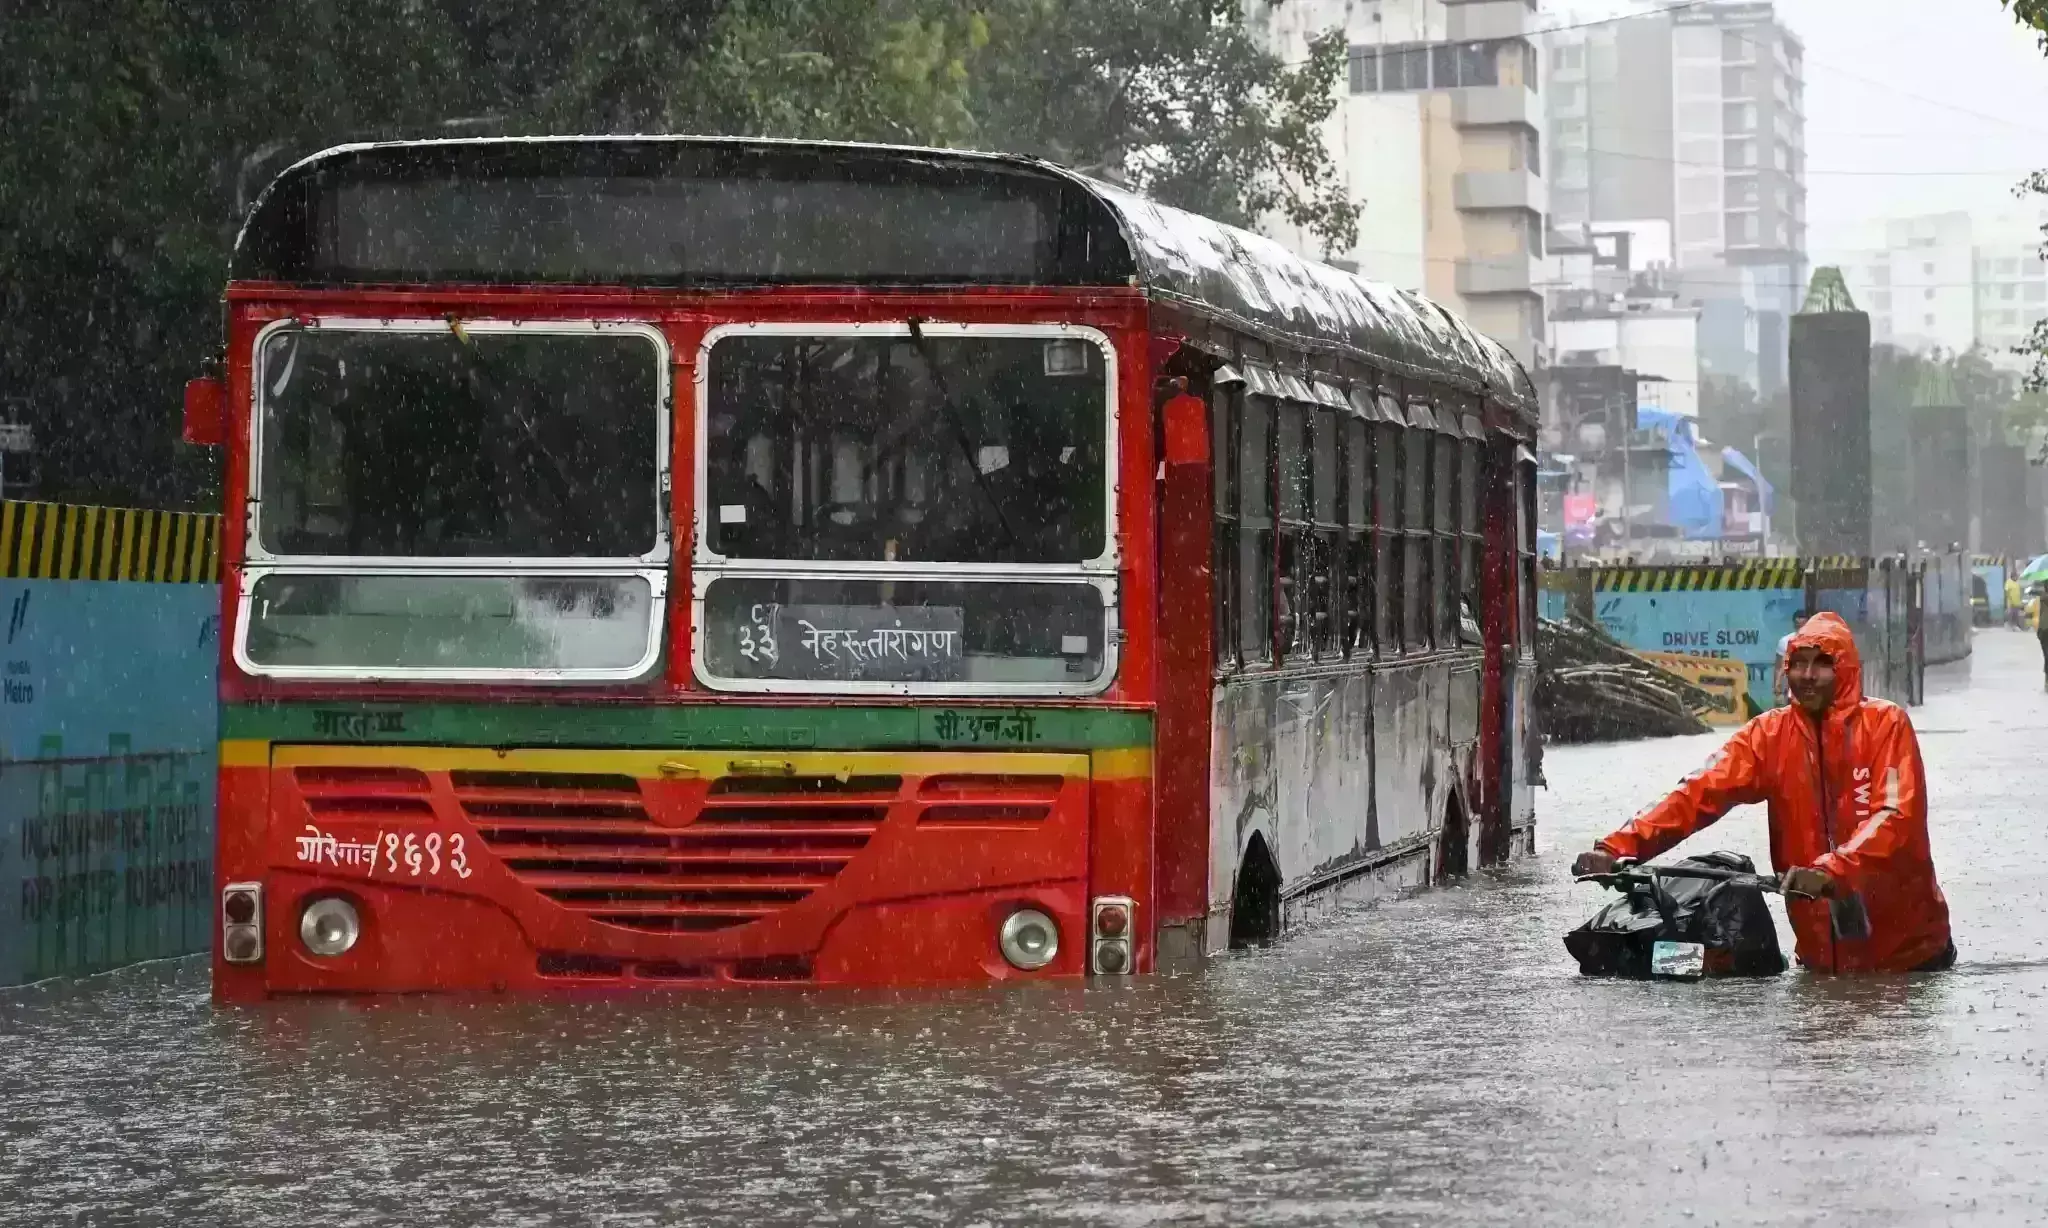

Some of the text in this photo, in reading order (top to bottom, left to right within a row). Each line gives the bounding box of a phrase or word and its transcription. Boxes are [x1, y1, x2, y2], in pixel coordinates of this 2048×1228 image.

[1662, 630, 1760, 646] DRIVE SLOW
[4, 678, 34, 704] Metro
